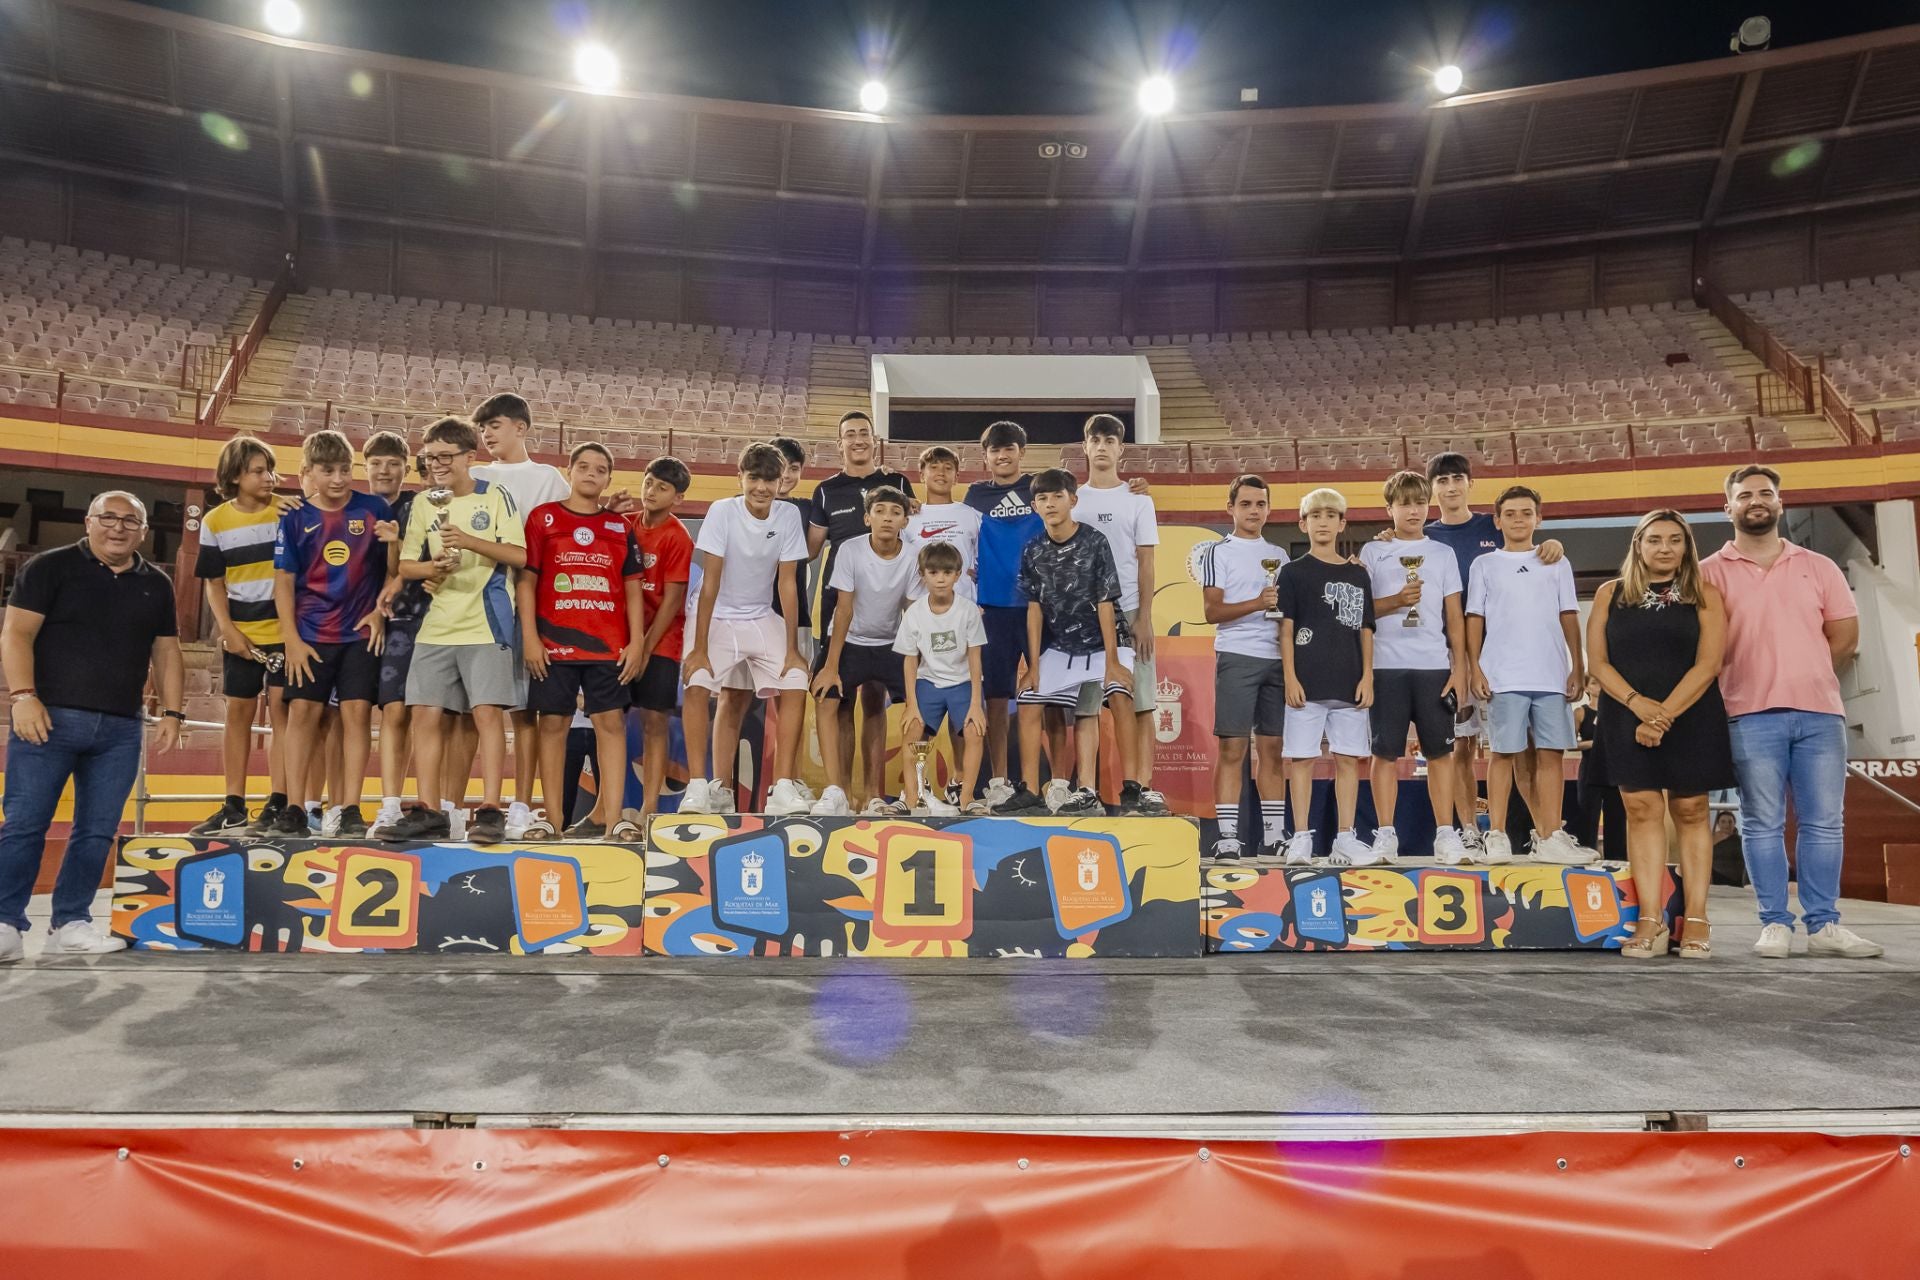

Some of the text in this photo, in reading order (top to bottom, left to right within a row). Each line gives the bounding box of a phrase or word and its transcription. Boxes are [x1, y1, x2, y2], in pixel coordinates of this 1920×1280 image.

[545, 513, 554, 526] 9
[990, 507, 1031, 517] adidas
[1098, 513, 1113, 521] NYC
[1846, 760, 1920, 778] RRAS
[900, 850, 945, 916] 1
[351, 868, 400, 927] 2
[1433, 885, 1467, 931] 3
